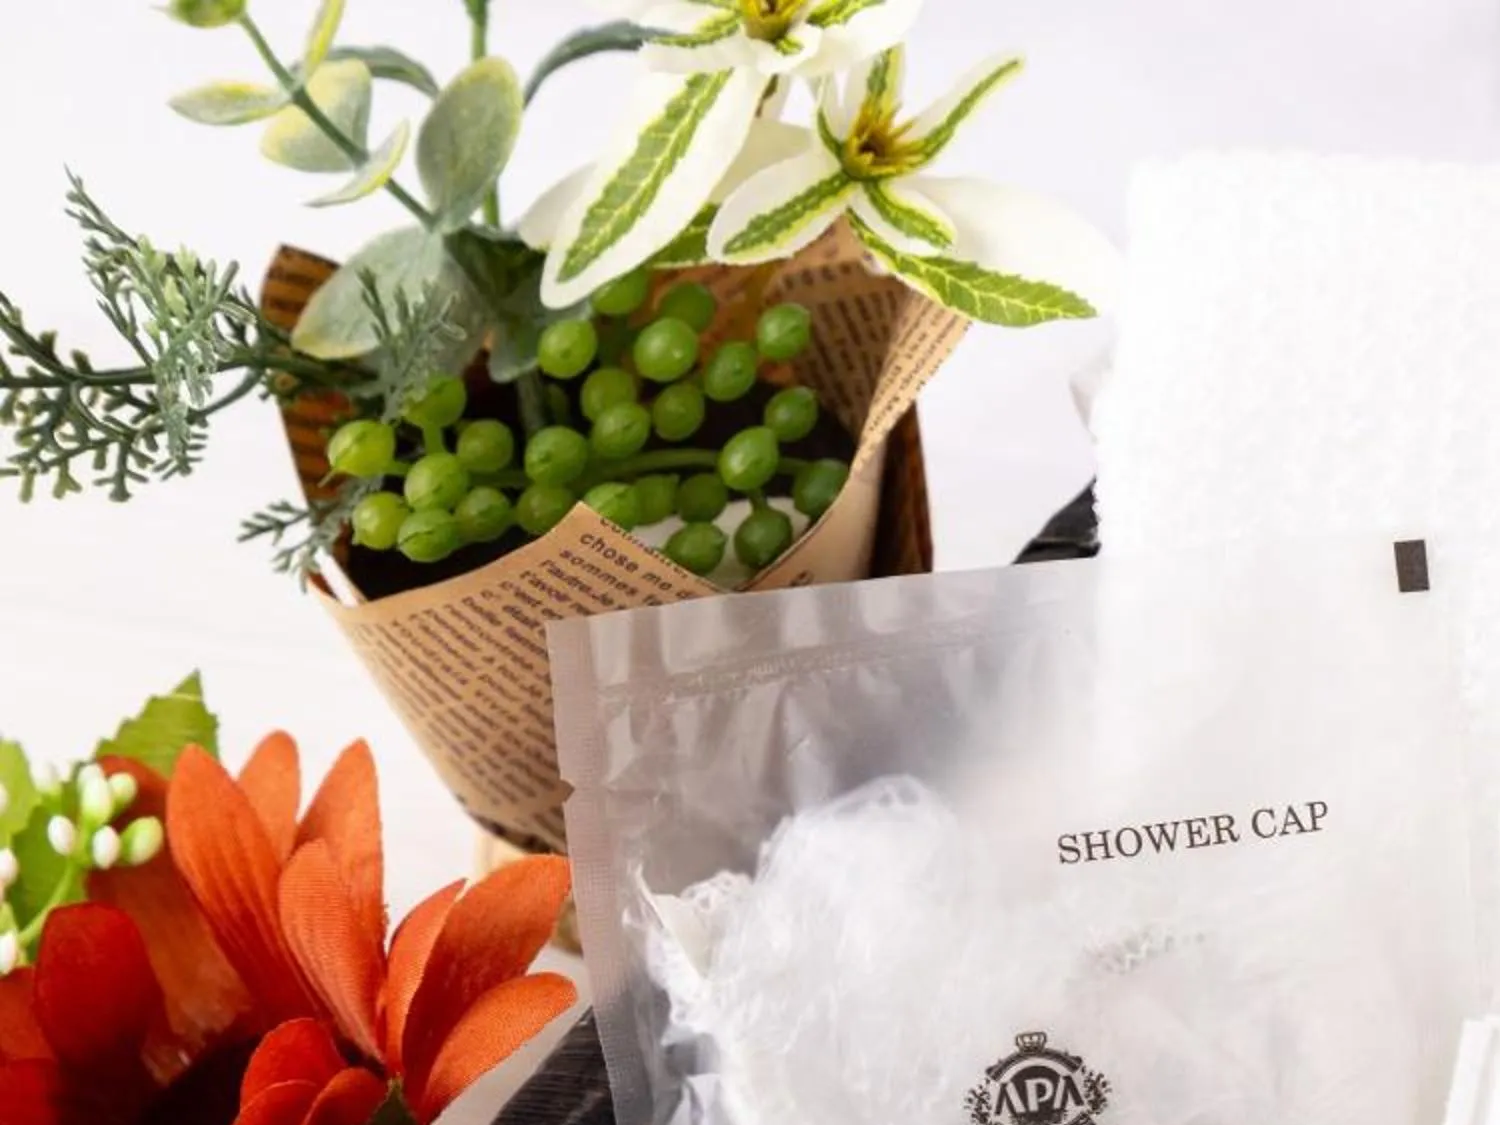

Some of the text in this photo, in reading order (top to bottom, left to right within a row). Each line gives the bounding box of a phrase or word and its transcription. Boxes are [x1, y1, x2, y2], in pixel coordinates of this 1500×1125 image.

[1058, 802, 1327, 863] SHOWER CAP
[995, 1074, 1084, 1119] APA
